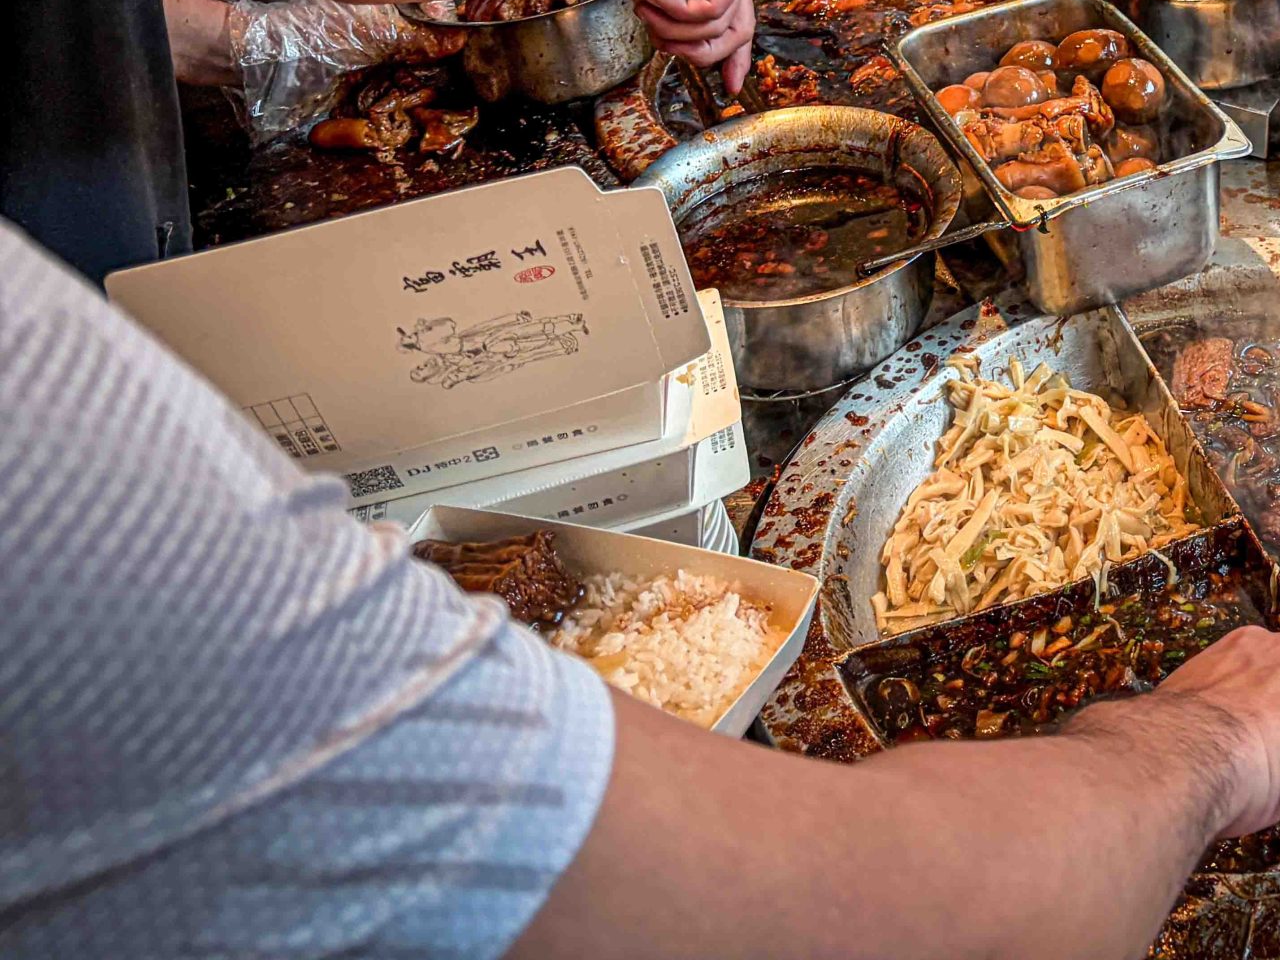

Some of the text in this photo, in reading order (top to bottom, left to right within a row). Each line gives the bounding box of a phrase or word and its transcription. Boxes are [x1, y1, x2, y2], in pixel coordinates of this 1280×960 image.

[403, 239, 546, 293] 富霸王
[407, 465, 431, 477] DJ
